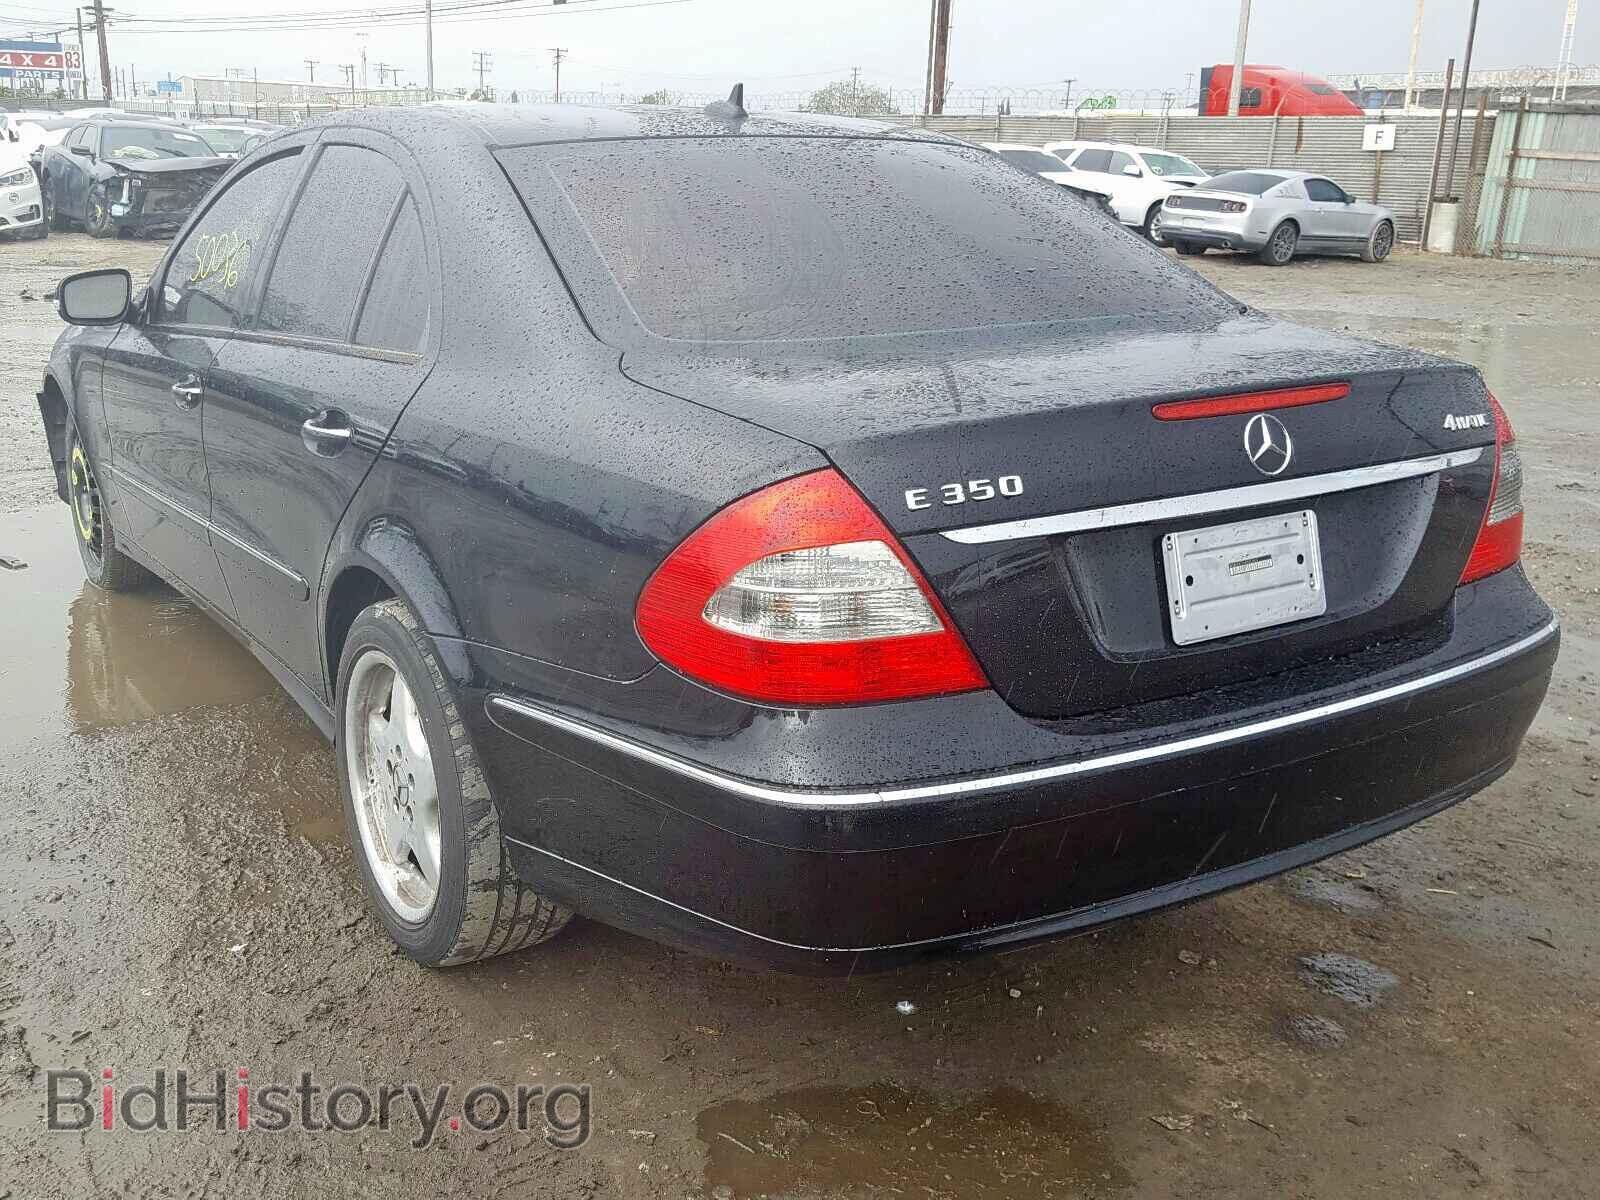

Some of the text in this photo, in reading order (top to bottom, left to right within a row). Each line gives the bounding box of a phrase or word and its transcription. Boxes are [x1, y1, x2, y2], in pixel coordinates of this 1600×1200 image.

[0, 54, 12, 65] 4
[44, 55, 58, 67] 4
[65, 51, 80, 69] 83
[15, 70, 60, 79] PARTS
[1375, 130, 1384, 144] F
[904, 475, 1024, 511] E 350
